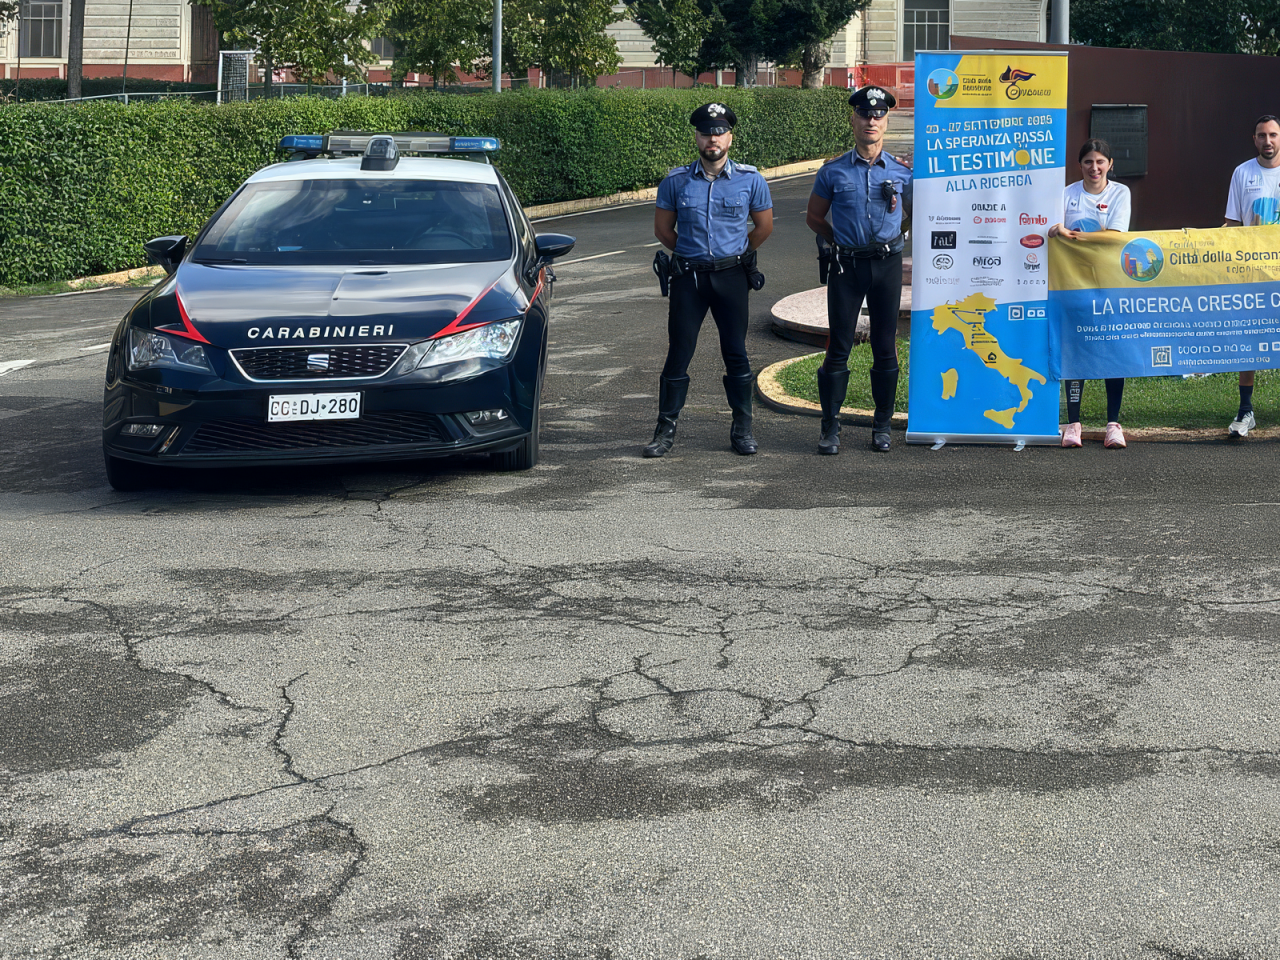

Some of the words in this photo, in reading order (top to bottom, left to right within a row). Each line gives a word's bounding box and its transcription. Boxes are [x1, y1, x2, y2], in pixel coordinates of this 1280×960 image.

[927, 138, 943, 151] LA
[945, 133, 1011, 149] SPERANZA
[1014, 130, 1054, 144] PASSA
[928, 156, 945, 174] IL
[946, 178, 977, 193] ALLA
[980, 174, 1033, 190] RICERCA
[1092, 298, 1115, 316] LA
[1118, 295, 1194, 314] RICERCA
[1197, 291, 1266, 313] CRESCE
[247, 324, 394, 339] CARABINIERI
